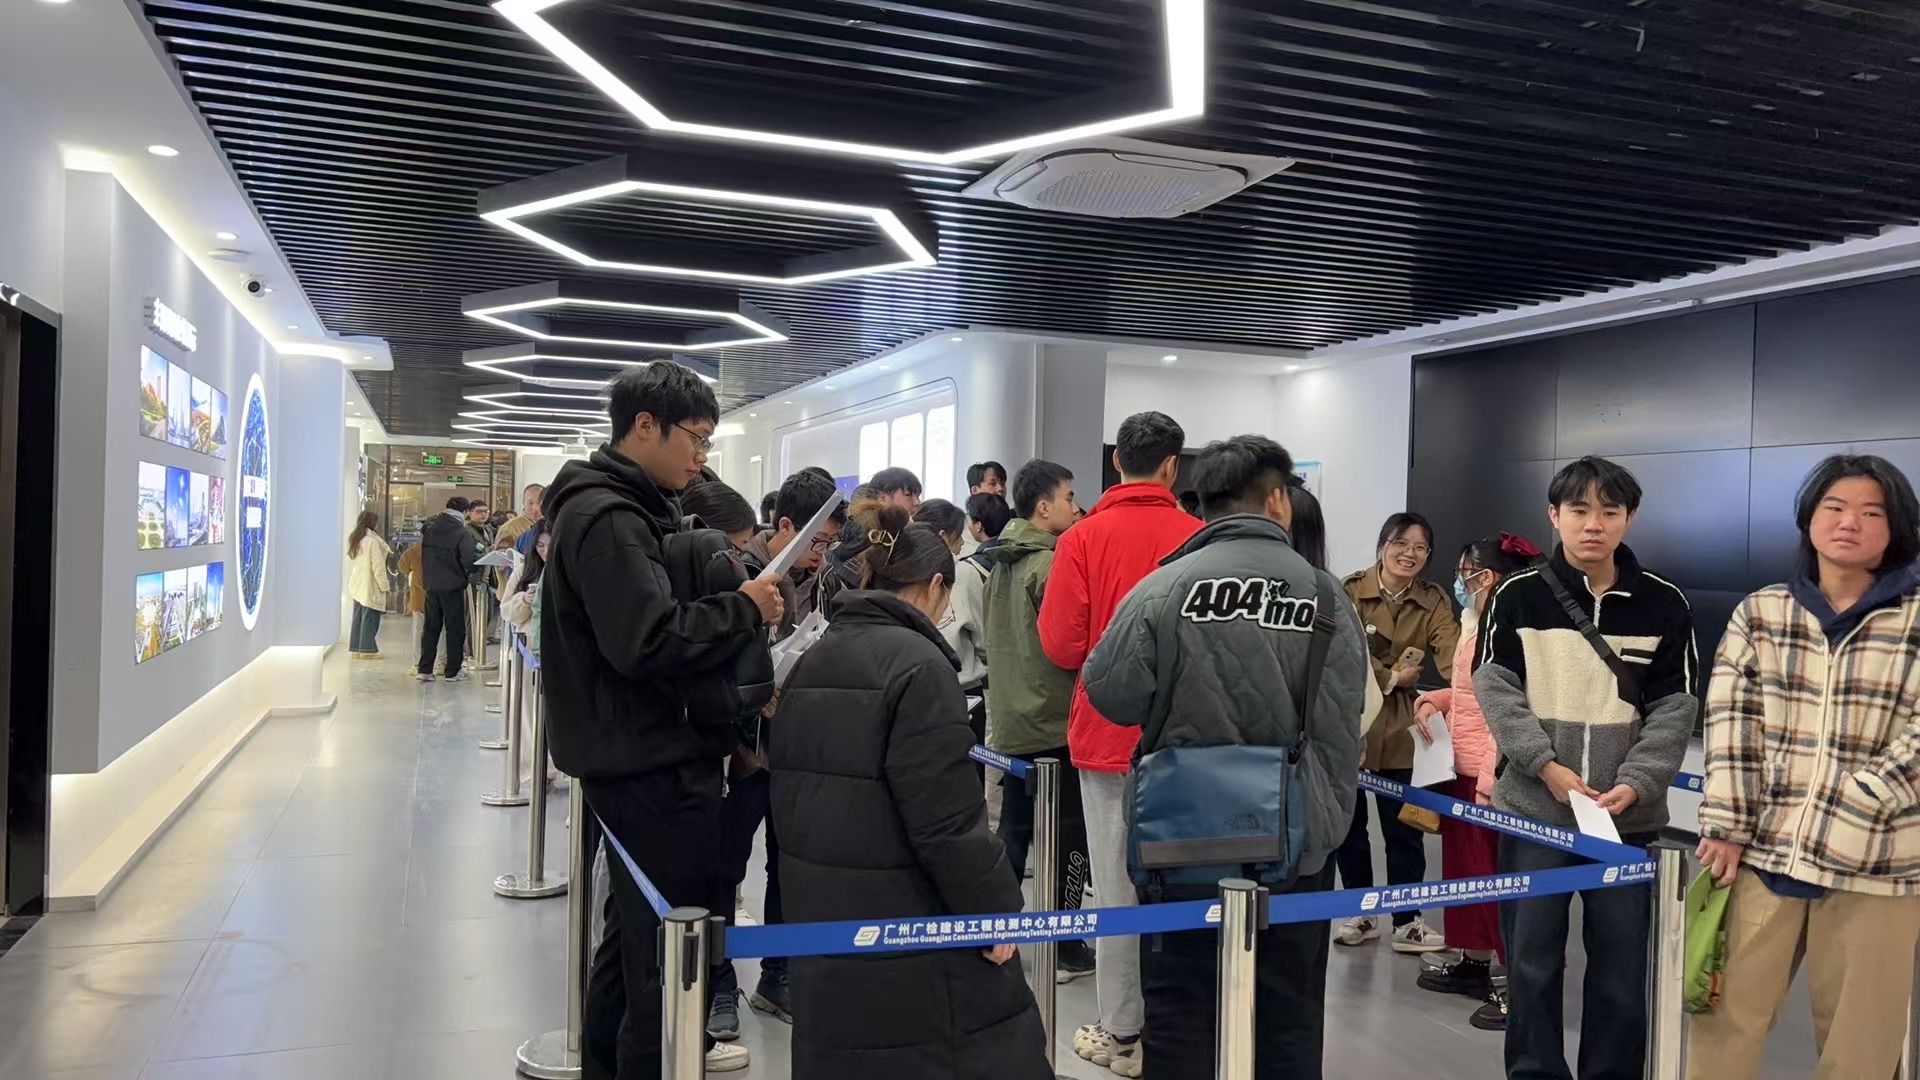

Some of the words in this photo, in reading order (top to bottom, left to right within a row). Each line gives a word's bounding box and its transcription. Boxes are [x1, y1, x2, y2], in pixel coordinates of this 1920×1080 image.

[1260, 598, 1318, 631] mo
[1382, 875, 1530, 901] 广州广检建设工程检测中心有限公司
[884, 913, 1098, 937] 广州广检建设工程检测中心有限公司
[883, 936, 919, 945] Guangzhou
[953, 931, 992, 941] Construction
